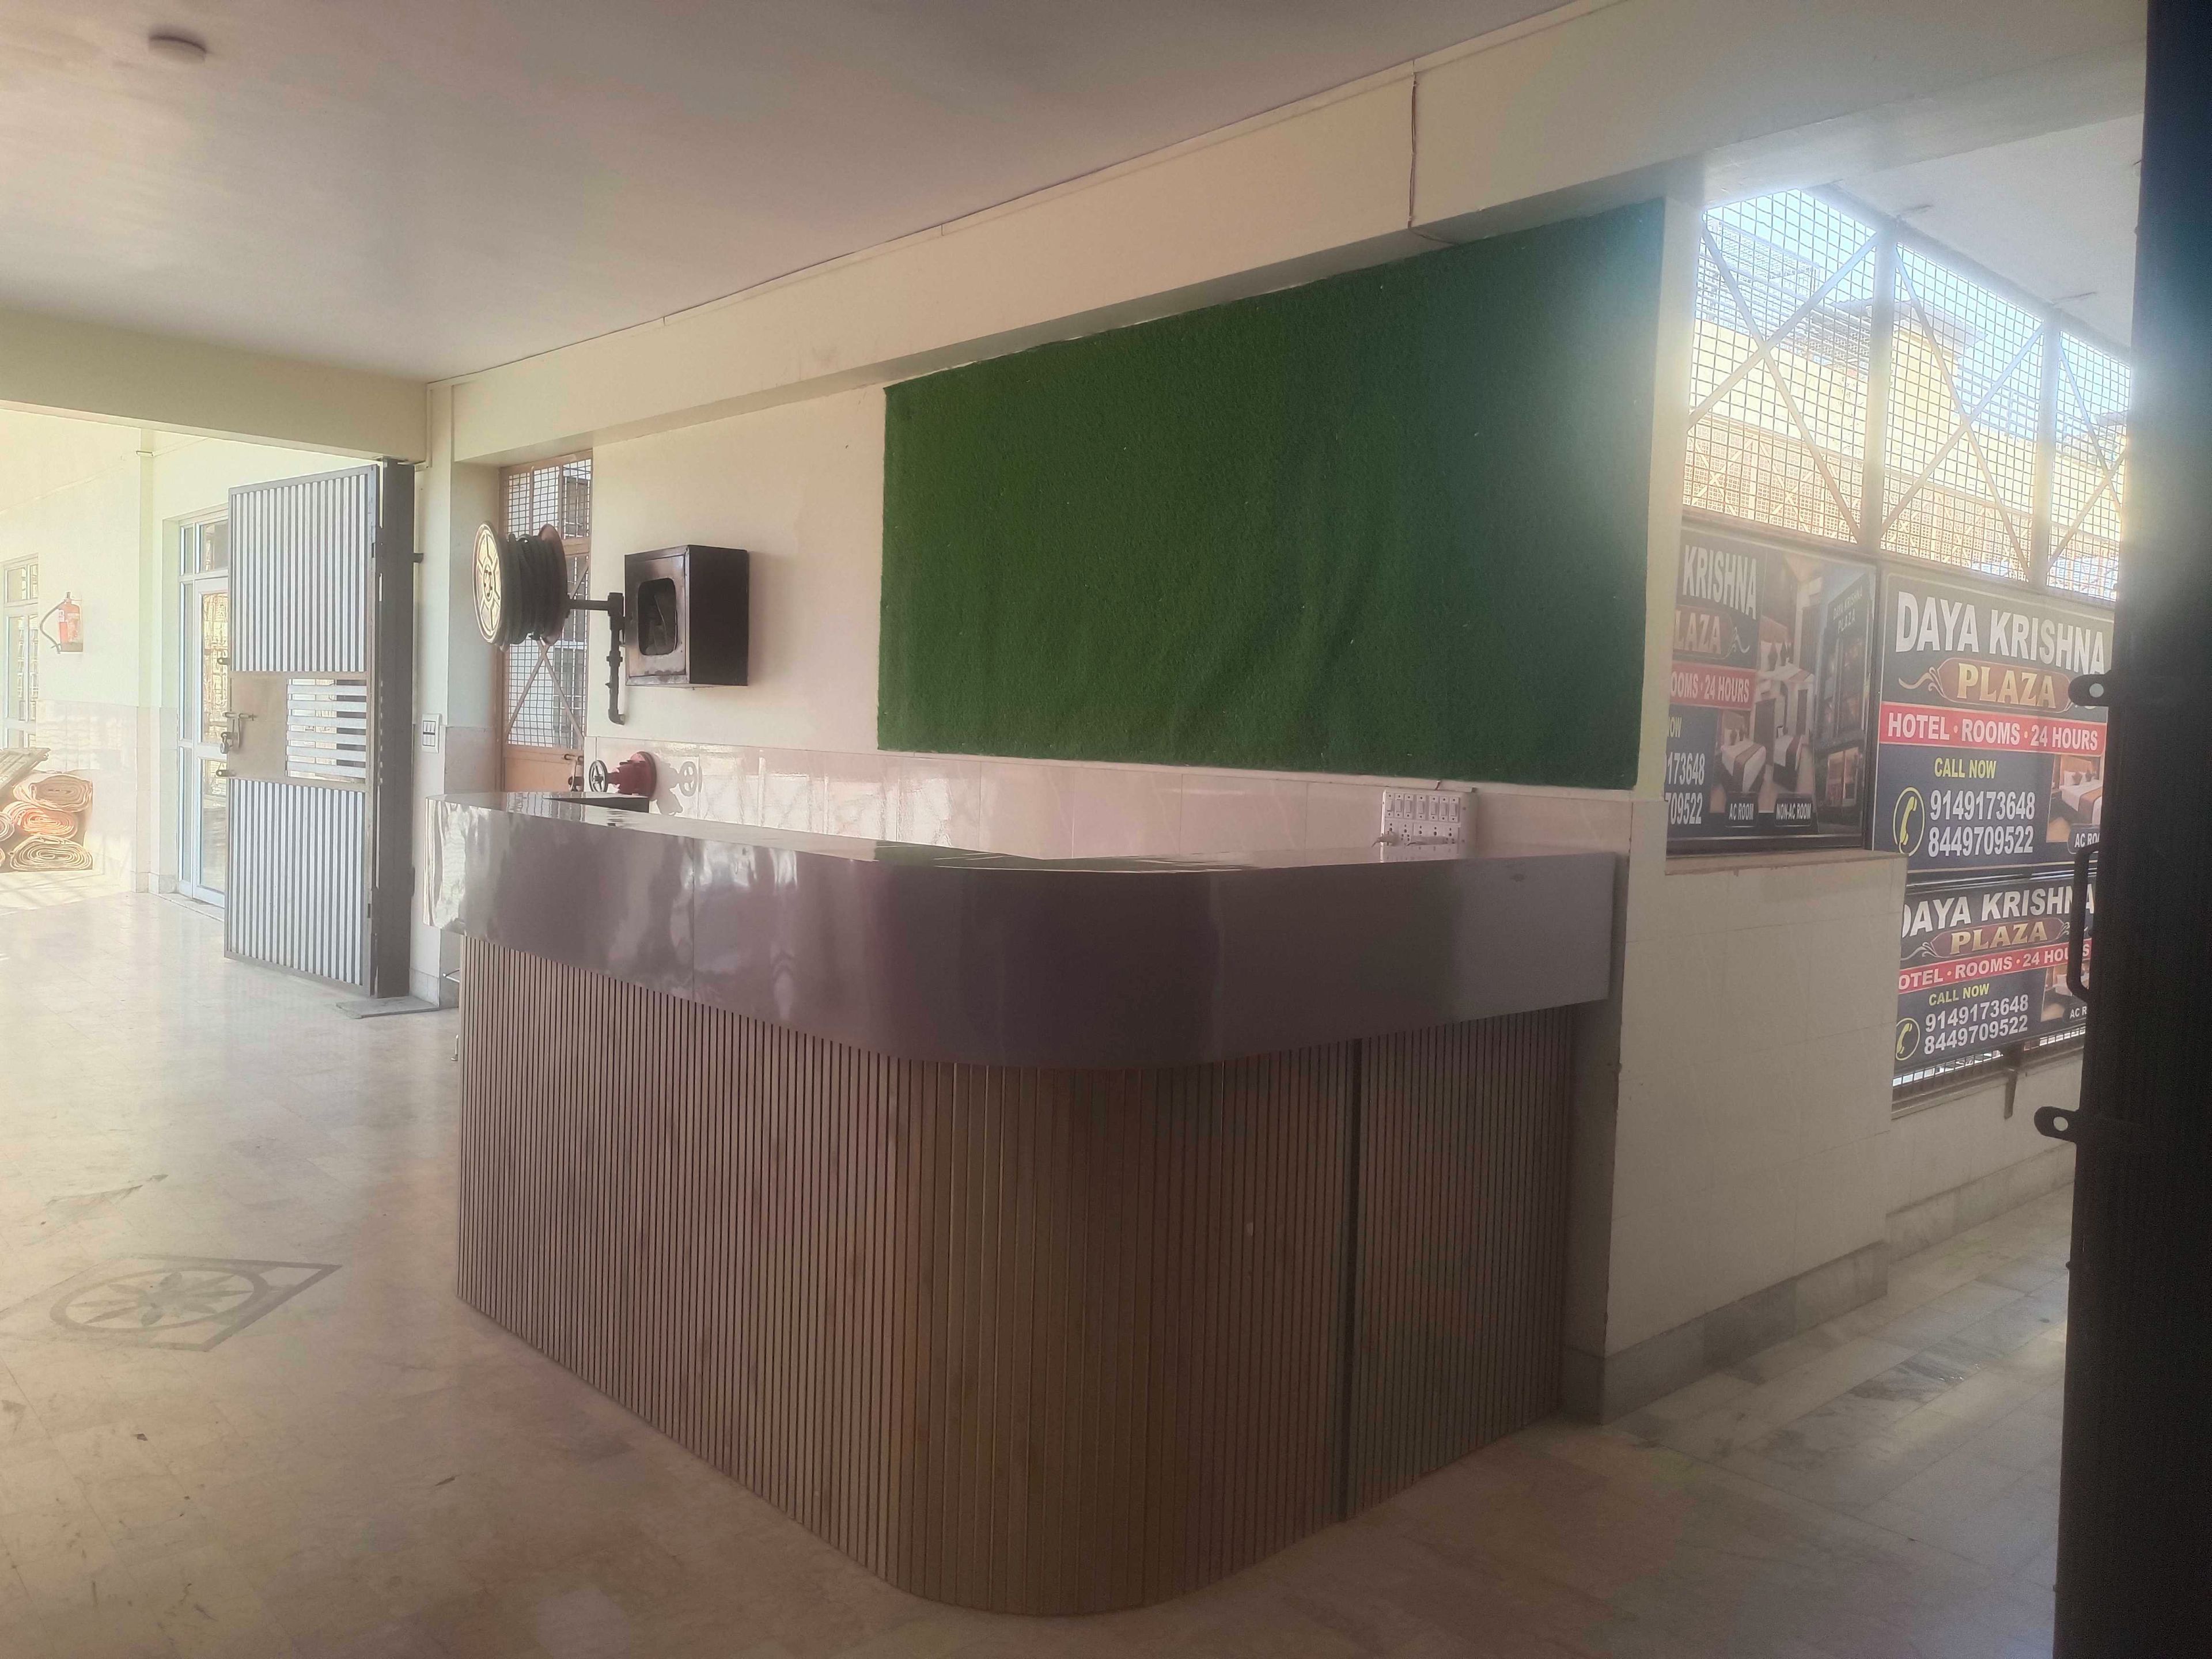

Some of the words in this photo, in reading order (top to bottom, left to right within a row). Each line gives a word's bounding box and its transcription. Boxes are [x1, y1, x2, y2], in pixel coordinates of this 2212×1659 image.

[1683, 545, 1756, 620] KRISHNA
[1896, 591, 1979, 653] DAYA
[1989, 608, 2104, 675] KRISHNA
[1704, 675, 1715, 700] 24
[1718, 676, 1749, 703] HOURS
[1957, 662, 2056, 709] PLAZA
[1888, 712, 1950, 741] HOTEL
[1961, 718, 2020, 745] ROOMS
[2030, 725, 2048, 747] 24
[2052, 726, 2098, 751] HOURS
[1665, 752, 1705, 785] 173648
[1934, 757, 1965, 778] CALL
[1969, 759, 1997, 779] NOW
[1729, 803, 1737, 820] AC
[1737, 802, 1754, 820] ROOM
[1796, 802, 1811, 820] ROOM
[1930, 789, 2036, 820] 9149173648
[1927, 825, 2033, 857] 8449709522
[2074, 833, 2085, 848] AC
[1950, 921, 2048, 956] PLAZA
[1955, 956, 2012, 979] ROOMS
[2023, 952, 2040, 967] 24
[2044, 944, 2090, 964] HOS
[1929, 989, 1959, 1006] CALL
[1962, 983, 1989, 999] NOW
[1925, 994, 2028, 1032] 9149173648
[2070, 1008, 2080, 1019] AC
[1924, 1014, 2028, 1055] 8449709522
